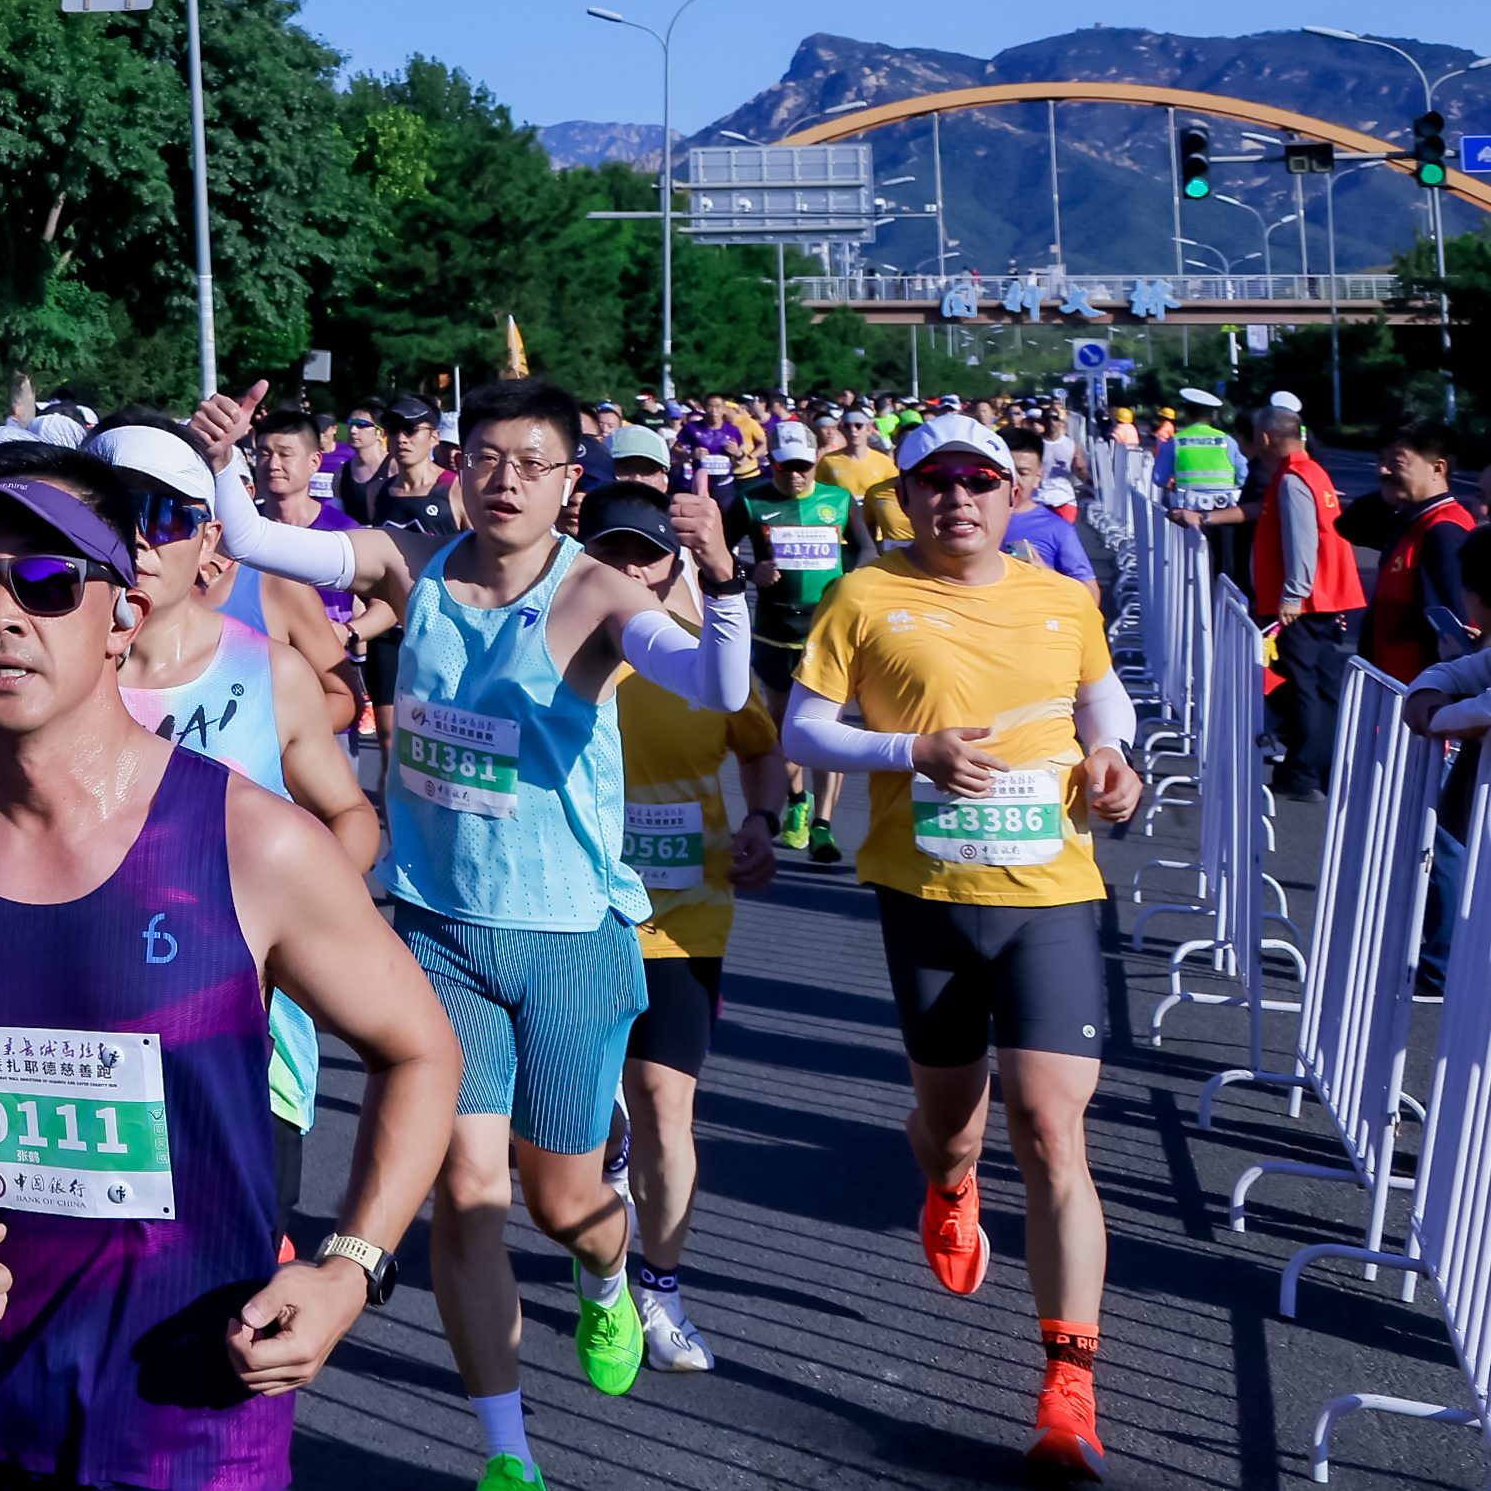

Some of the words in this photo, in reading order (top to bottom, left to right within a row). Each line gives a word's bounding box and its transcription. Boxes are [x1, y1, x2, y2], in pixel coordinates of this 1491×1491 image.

[783, 543, 830, 556] A1770
[411, 736, 497, 782] B1381
[937, 805, 1043, 833] B3386
[16, 1195, 41, 1204] BANK
[43, 1197, 55, 1205] OF
[57, 1199, 87, 1209] CHINA
